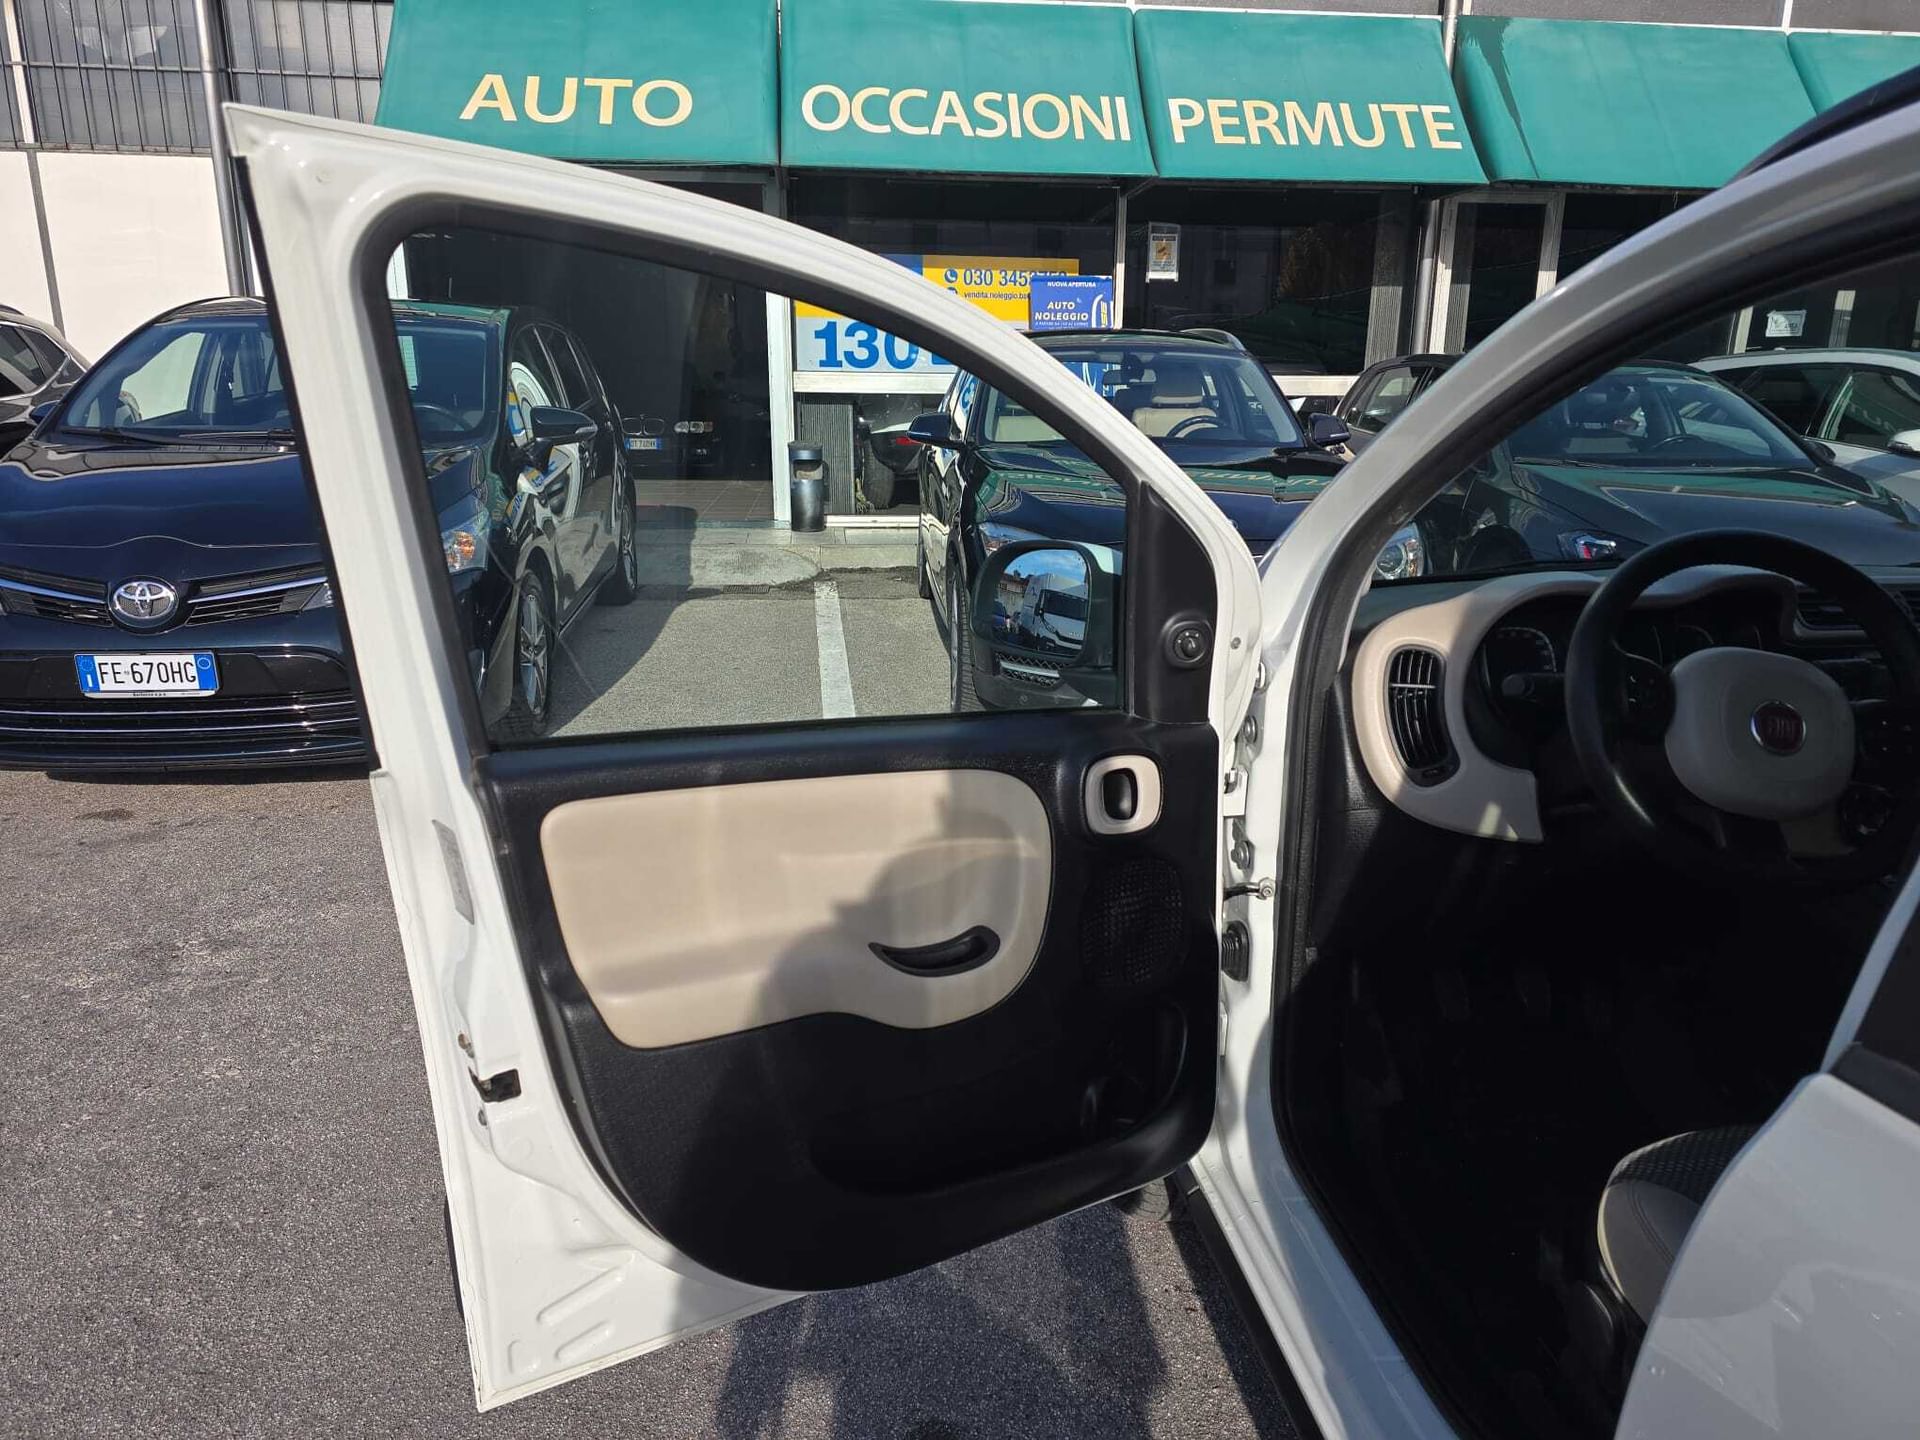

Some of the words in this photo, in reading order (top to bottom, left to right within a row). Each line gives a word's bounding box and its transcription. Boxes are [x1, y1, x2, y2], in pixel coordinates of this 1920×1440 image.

[459, 73, 694, 127] AUTO
[801, 84, 1132, 141] OCCASIONI
[1167, 98, 1463, 150] PERMUTE
[963, 269, 994, 286] 030
[1047, 301, 1076, 310] AUTO
[1034, 312, 1089, 321] NOLEGGIO
[98, 662, 126, 684] FE
[130, 661, 197, 684] 670HG
